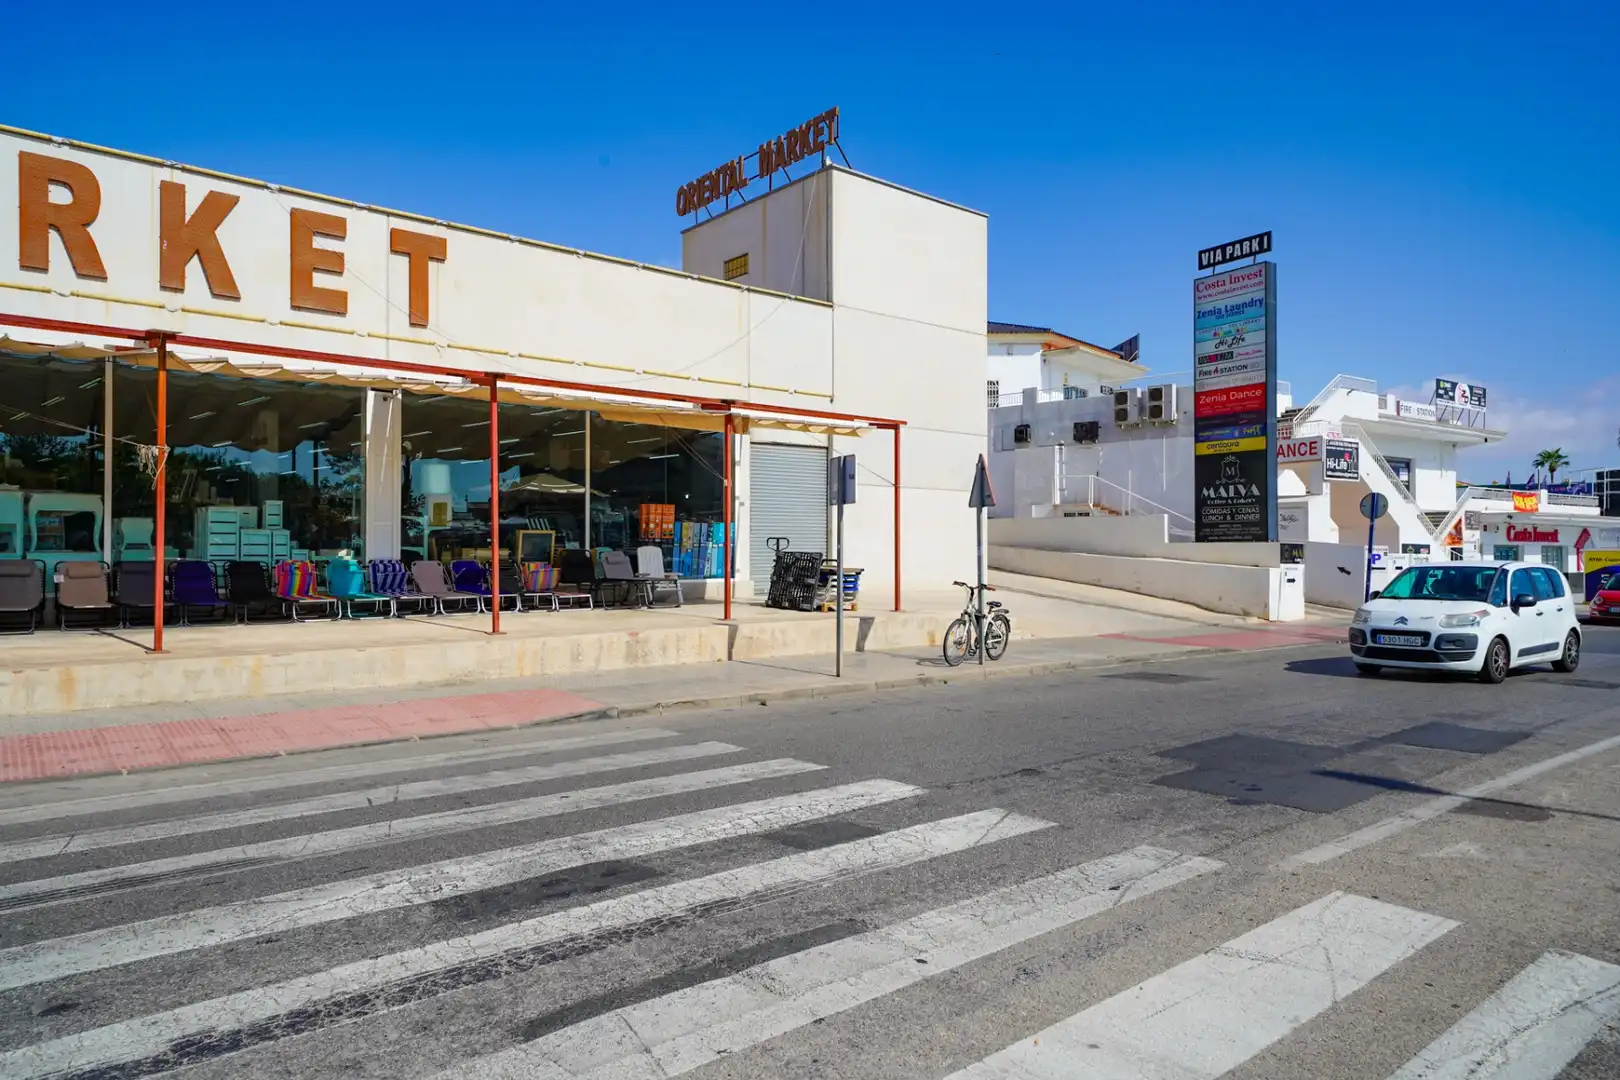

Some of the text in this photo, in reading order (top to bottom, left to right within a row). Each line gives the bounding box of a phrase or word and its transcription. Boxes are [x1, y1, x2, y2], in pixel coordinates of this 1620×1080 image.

[676, 105, 840, 217] ORIENTAL MARKET
[18, 150, 447, 328] RKET
[1201, 235, 1268, 266] VIA PARK I
[1196, 268, 1263, 293] Costa Invest
[1197, 297, 1264, 320] Zenia Laundry
[1214, 335, 1246, 349] Hi Life
[1219, 363, 1248, 375] STATION
[1199, 389, 1263, 404] Zenia Dance
[1400, 404, 1412, 414] FIRE
[1326, 457, 1348, 470] Hi-Life
[1201, 483, 1261, 499] MALVA
[1202, 506, 1231, 515] COMIDAS
[1237, 506, 1260, 514] CENAS
[1202, 514, 1224, 522] LUNCH
[1234, 513, 1260, 521] DINNER
[1506, 523, 1560, 543] Costa Invest
[1382, 635, 1401, 644] 5301
